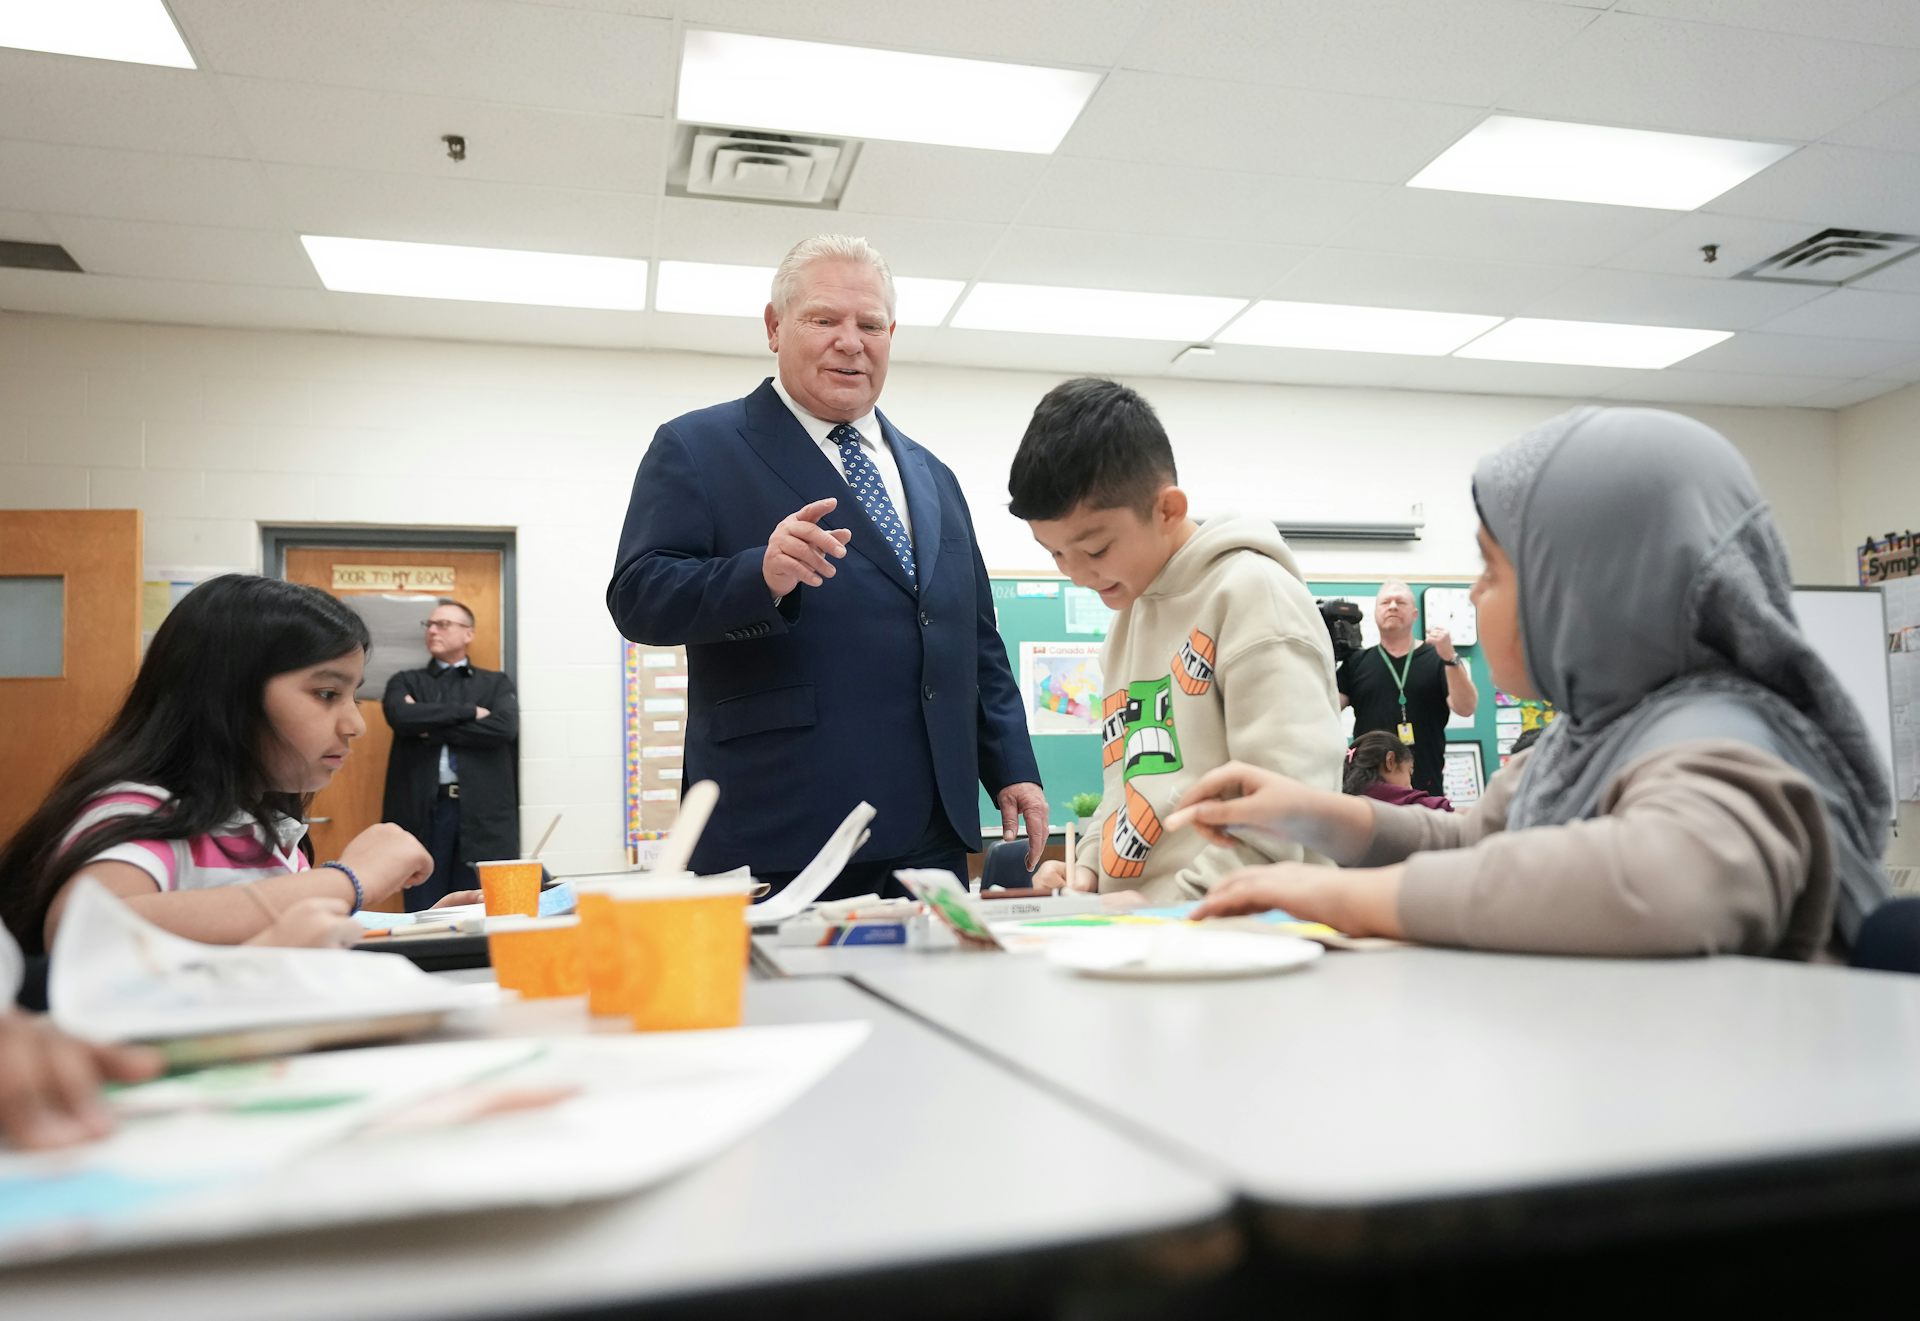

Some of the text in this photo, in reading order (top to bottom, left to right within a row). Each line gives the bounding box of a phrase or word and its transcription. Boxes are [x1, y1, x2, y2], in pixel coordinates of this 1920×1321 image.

[1862, 529, 1920, 556] A Trip
[392, 570, 411, 584] MY
[1869, 556, 1919, 581] Symp
[1049, 646, 1085, 655] Canada
[1125, 834, 1150, 859] TNT
